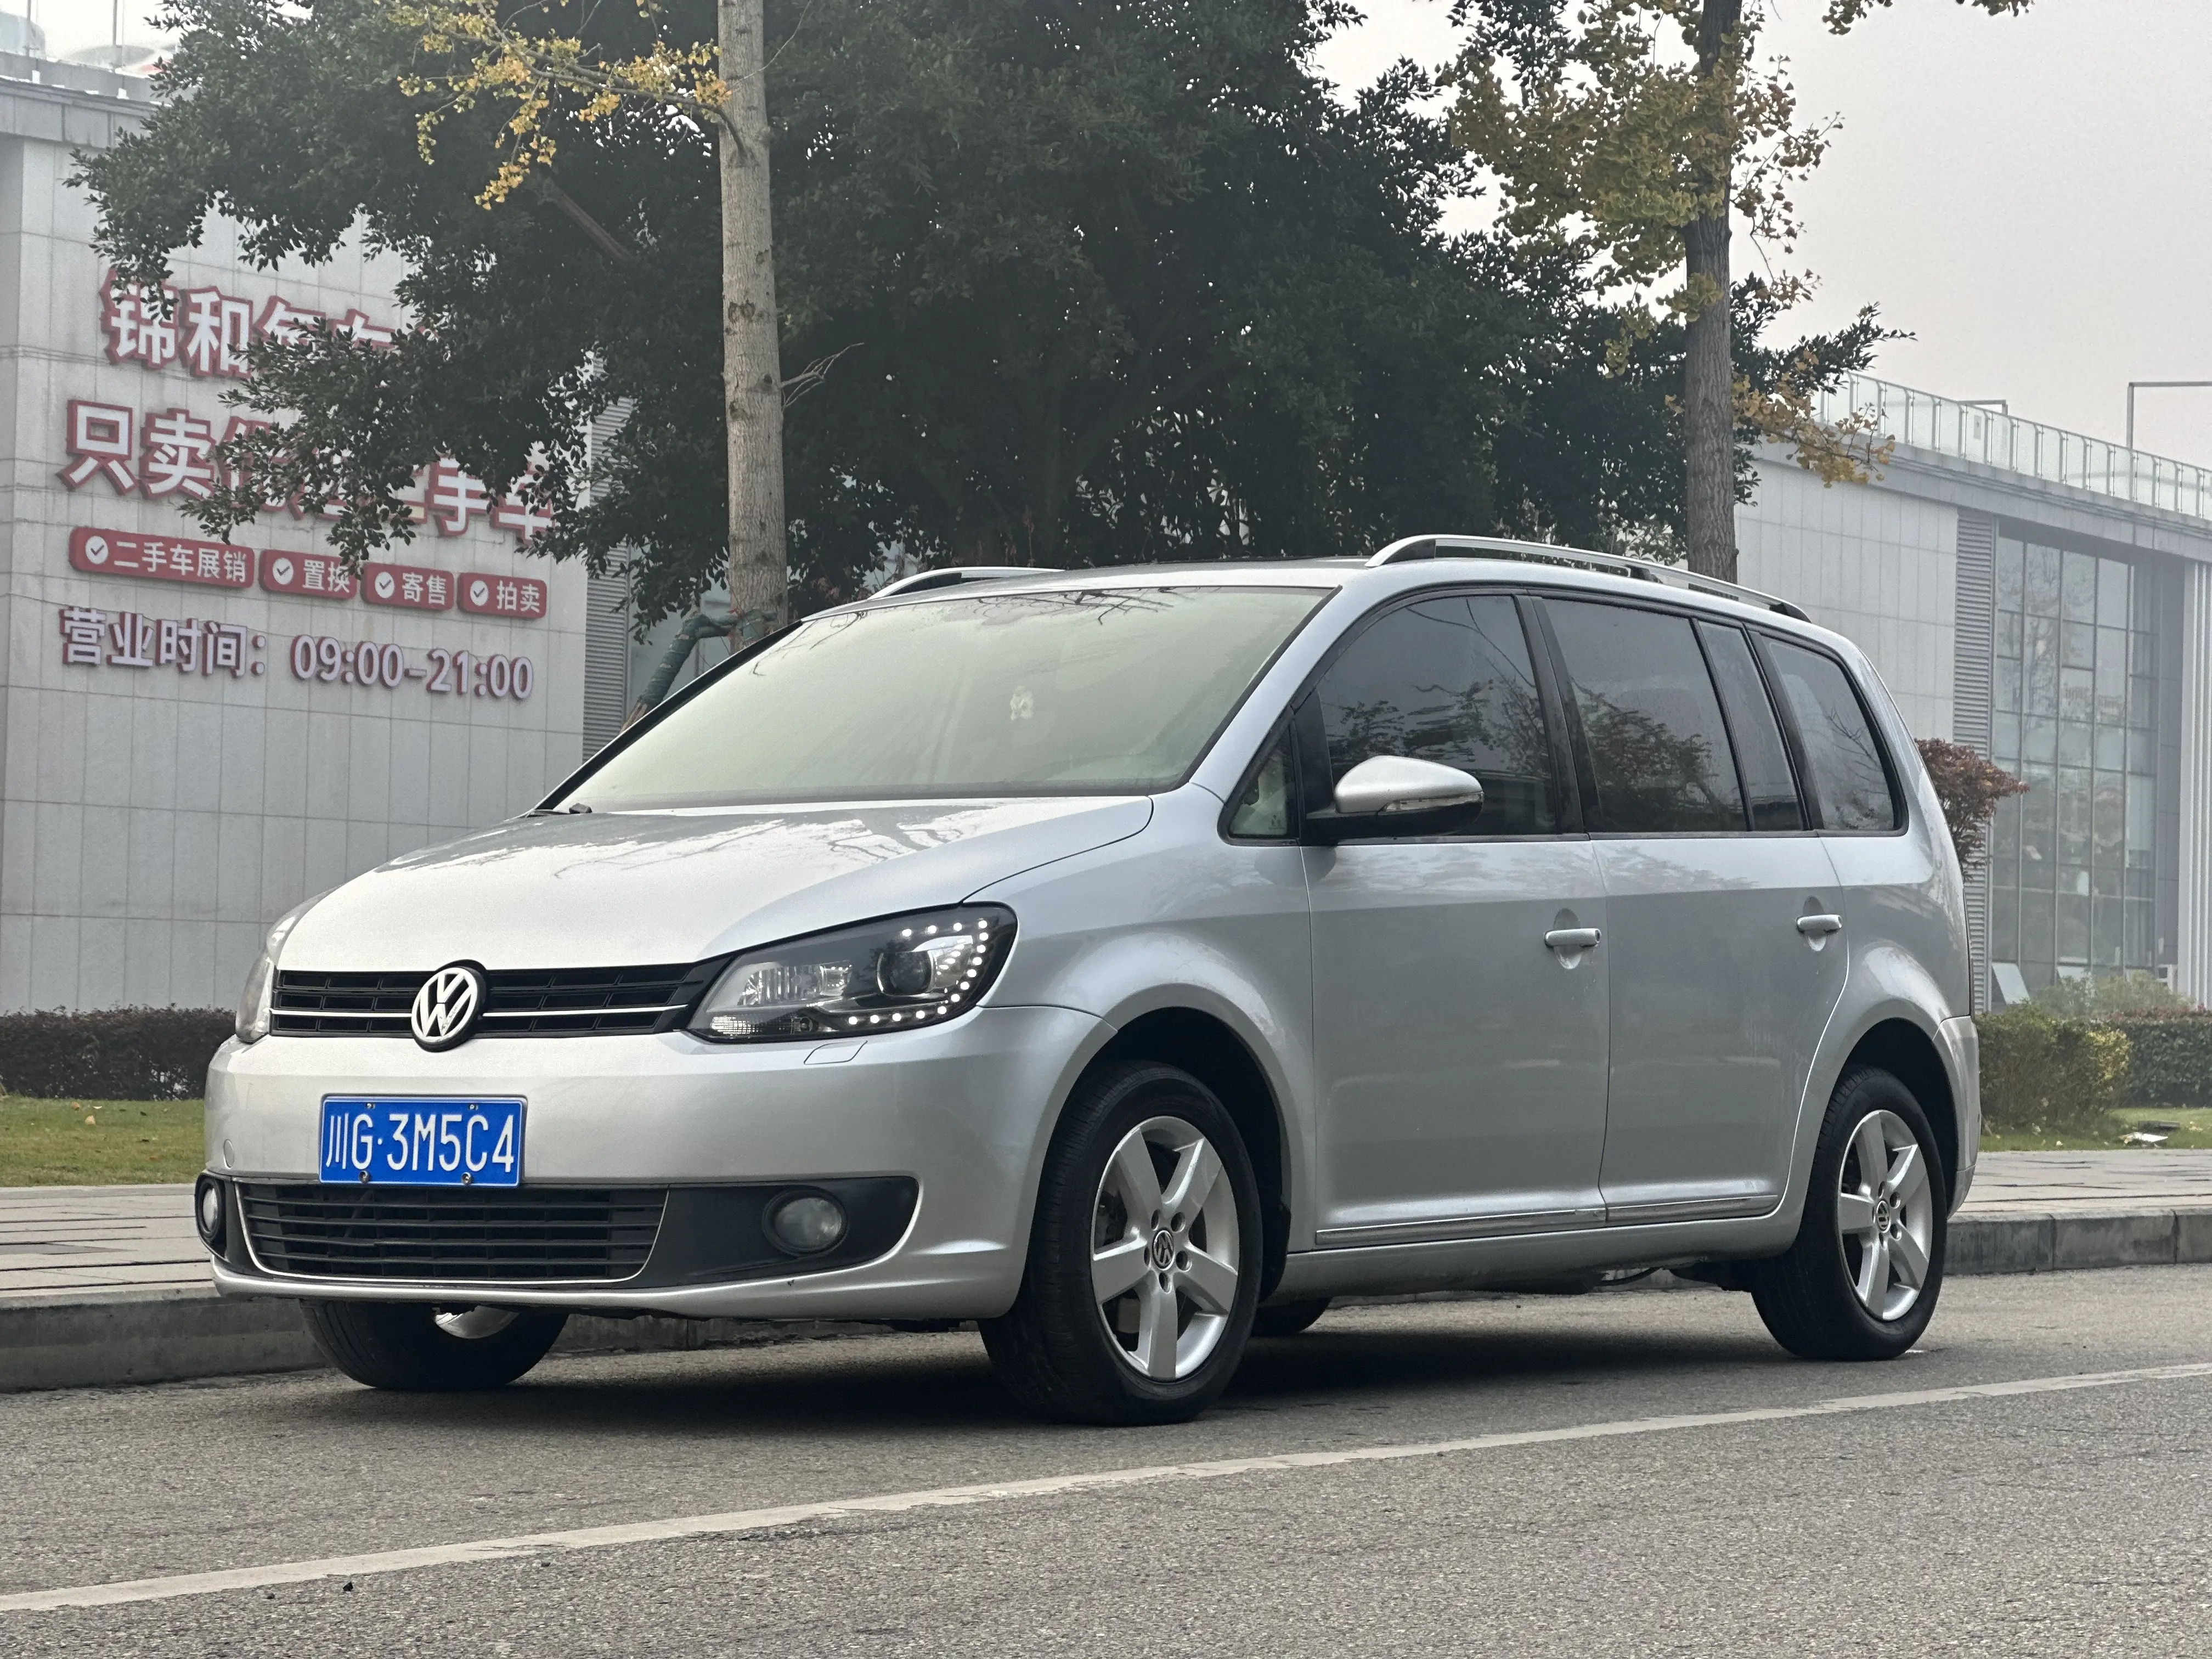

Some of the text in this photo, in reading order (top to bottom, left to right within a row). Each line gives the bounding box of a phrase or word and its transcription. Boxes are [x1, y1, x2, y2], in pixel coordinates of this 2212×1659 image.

[114, 540, 247, 583] 二手车展销
[302, 558, 351, 593] 置换
[401, 572, 447, 606] 寄售
[496, 580, 541, 613] 拍卖
[290, 634, 534, 701] 09:00-21:00
